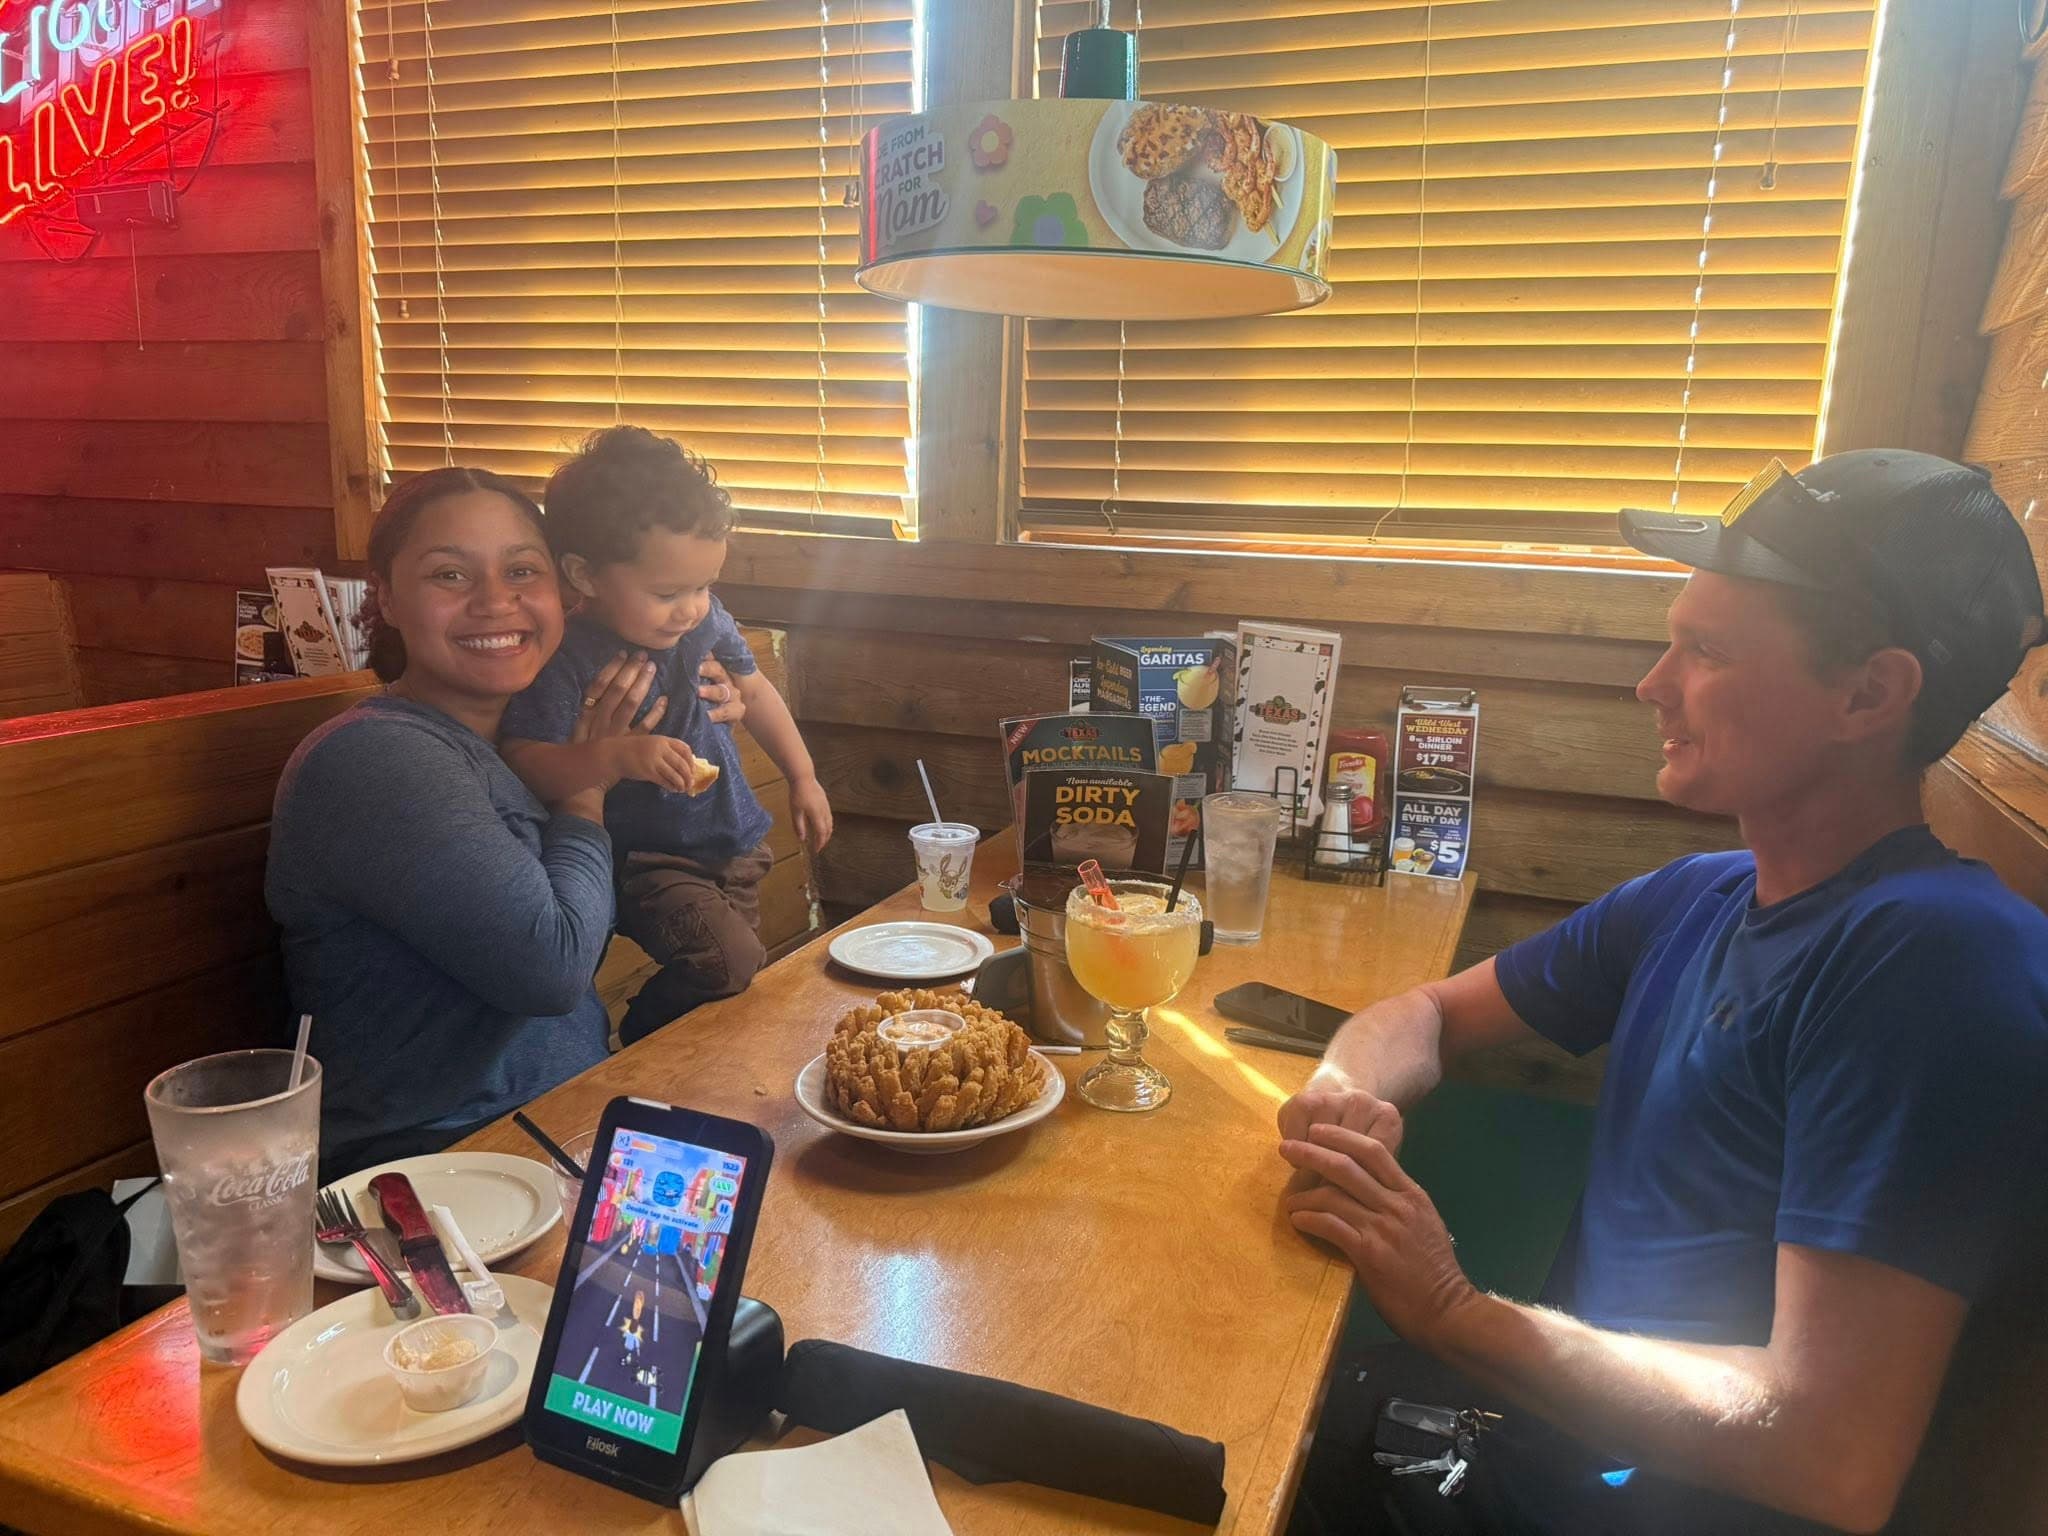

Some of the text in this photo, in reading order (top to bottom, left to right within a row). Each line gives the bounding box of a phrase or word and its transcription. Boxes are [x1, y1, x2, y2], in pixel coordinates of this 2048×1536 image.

[891, 126, 924, 152] FROM
[898, 176, 921, 195] FOR
[1010, 724, 1028, 745] NEW
[1406, 725, 1469, 735] WEDNESDAY
[1427, 736, 1463, 744] SIRLOIN
[1022, 745, 1142, 765] MOCKTAILS
[1065, 777, 1089, 785] Now
[1055, 786, 1140, 806] DIRTY
[1055, 807, 1136, 827] SODA
[1402, 804, 1461, 817] ALL DAY
[1402, 814, 1461, 825] EVERY DAY
[1430, 840, 1461, 864] $5
[626, 1204, 699, 1229] Double tap to activate
[572, 1391, 655, 1434] PLAY NOW
